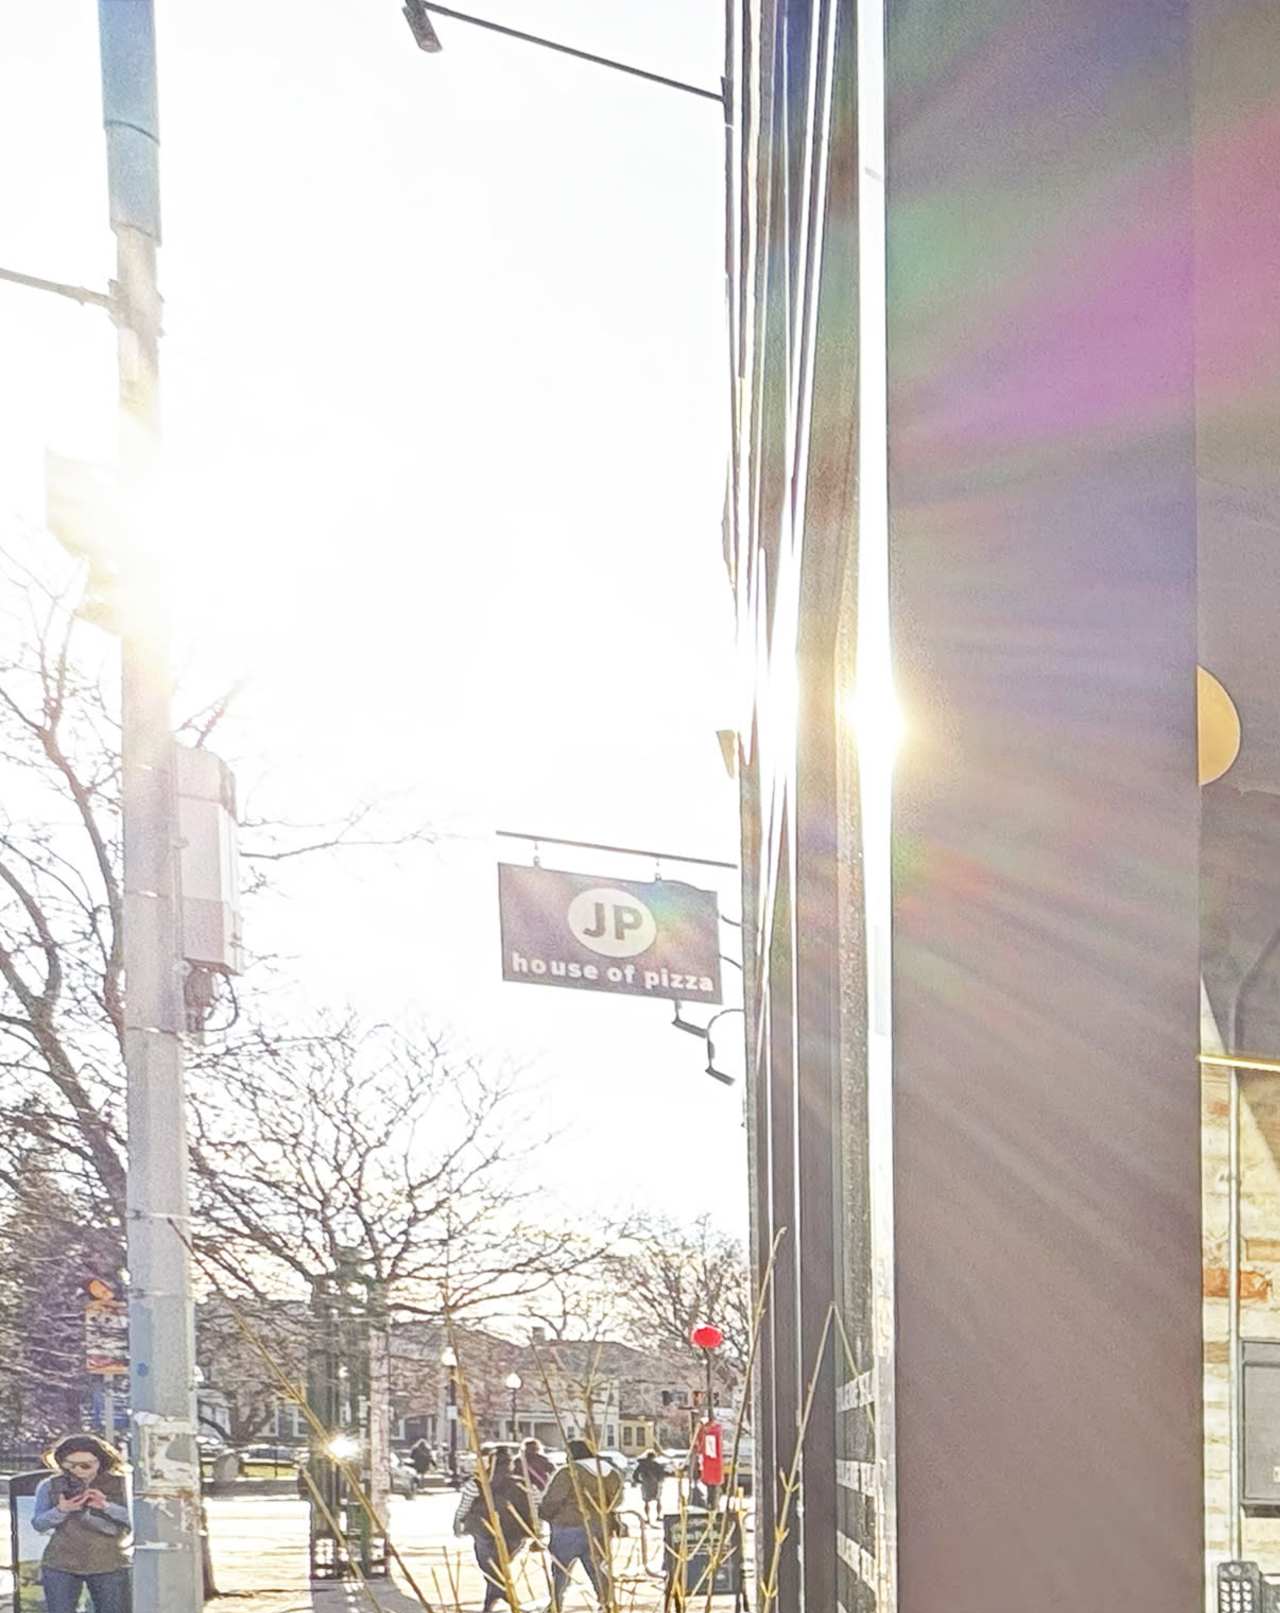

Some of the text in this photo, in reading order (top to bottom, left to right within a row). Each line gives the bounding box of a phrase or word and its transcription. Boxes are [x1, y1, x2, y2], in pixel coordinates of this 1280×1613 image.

[583, 902, 643, 940] JP
[512, 952, 715, 992] house of pizza
